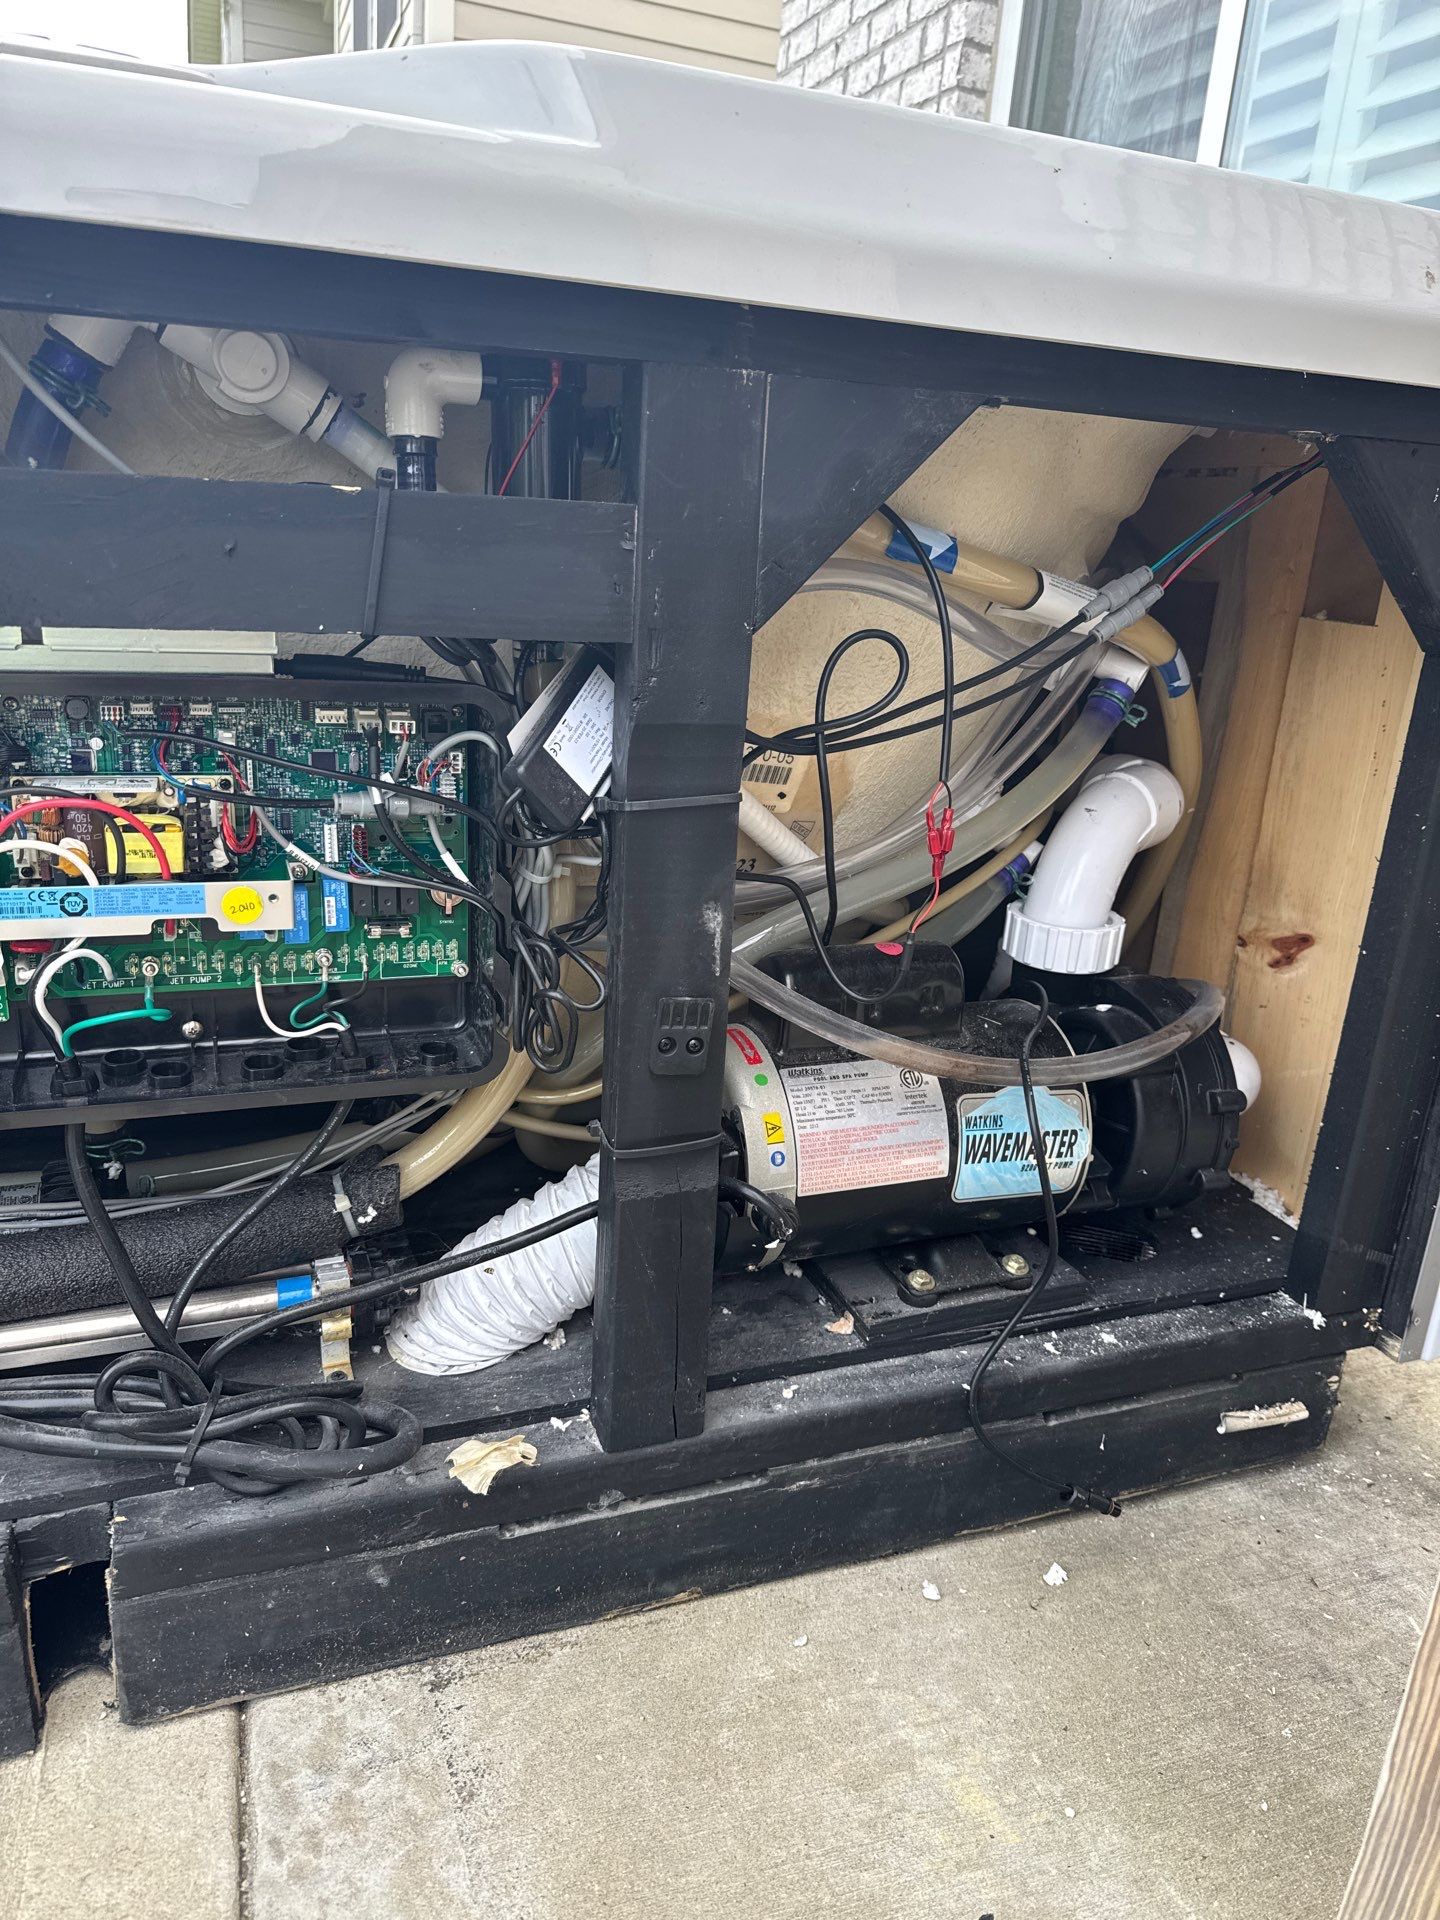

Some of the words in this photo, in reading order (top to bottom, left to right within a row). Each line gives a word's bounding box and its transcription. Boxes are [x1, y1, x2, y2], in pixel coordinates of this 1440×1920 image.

[190, 976, 212, 984] PUMP
[217, 975, 222, 983] 2
[102, 980, 125, 989] PUMP
[788, 1067, 824, 1078] Watkins
[904, 1092, 928, 1100] Intertek
[965, 1115, 1004, 1130] WATKINS
[964, 1129, 1079, 1165] WAVEMASTER
[1053, 1161, 1073, 1170] PUMP
